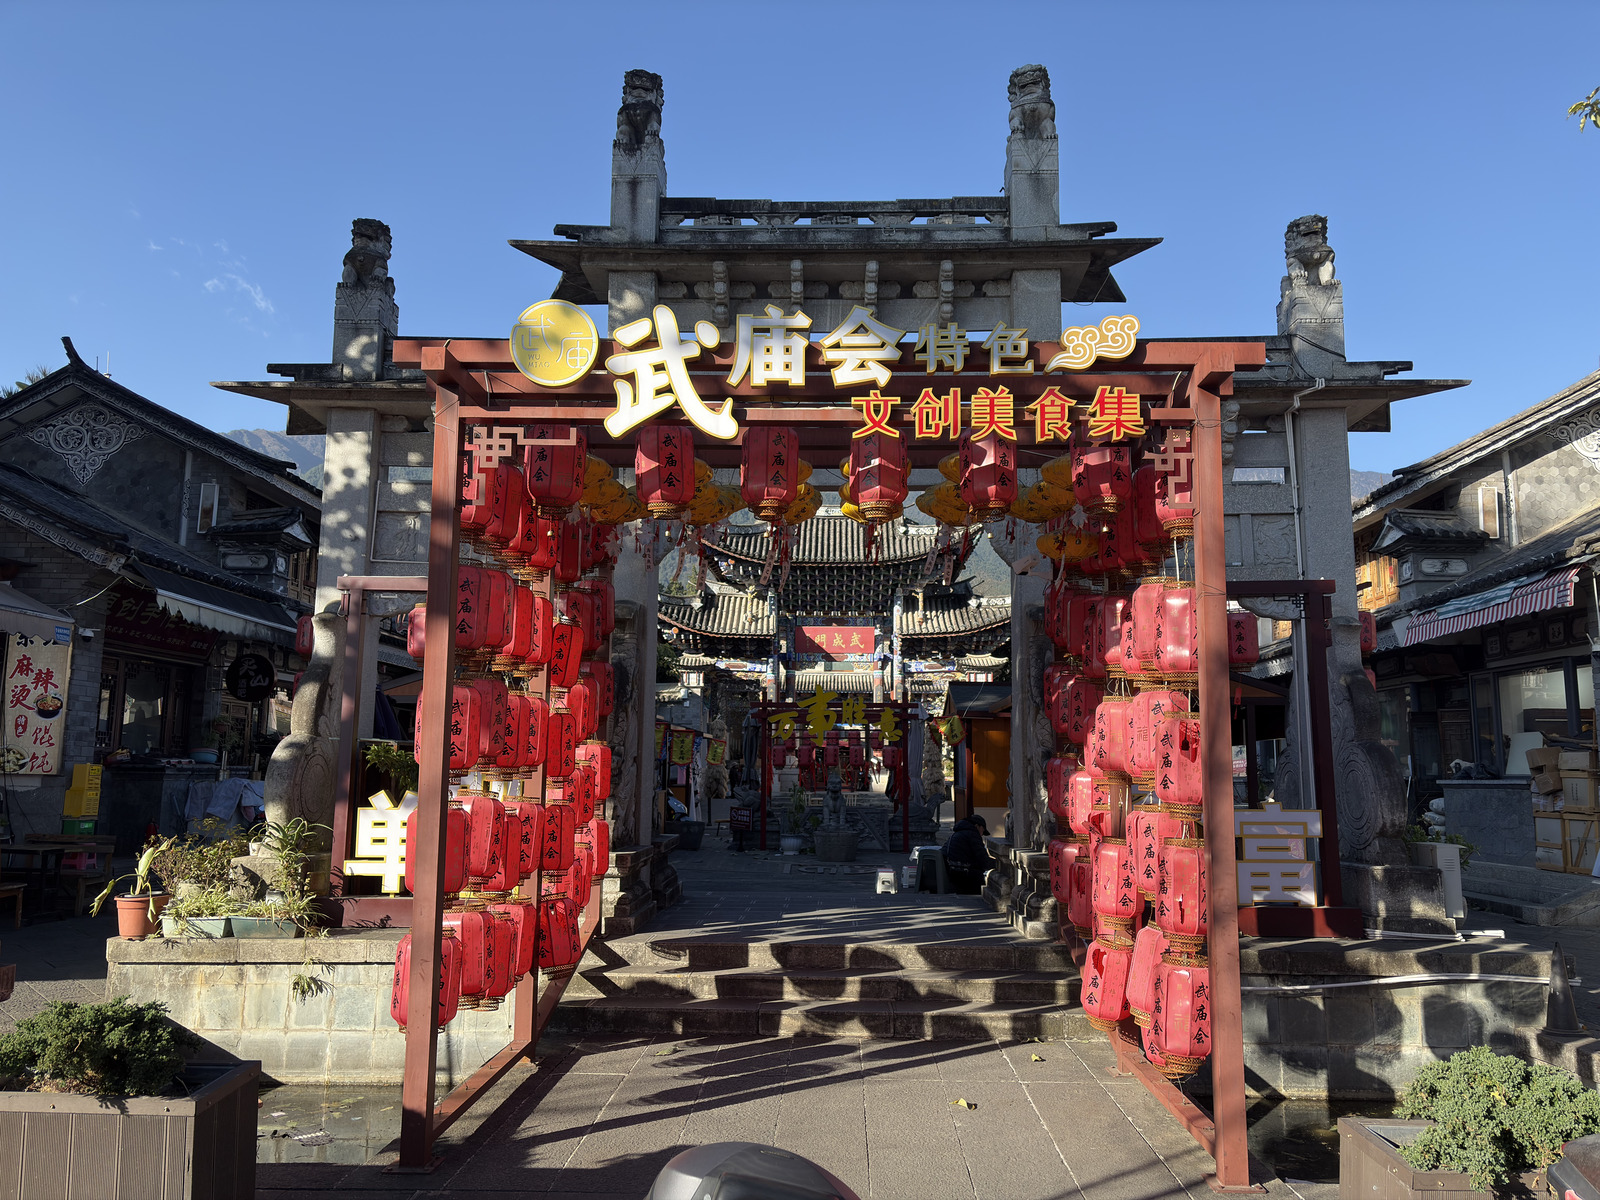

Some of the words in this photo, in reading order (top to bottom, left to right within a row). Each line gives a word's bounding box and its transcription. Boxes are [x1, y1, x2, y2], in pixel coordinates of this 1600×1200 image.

[528, 353, 541, 361] WU
[528, 361, 550, 369] MIAO
[851, 385, 1146, 444] 文创美食集
[662, 433, 681, 488] 武庙会
[770, 432, 788, 487] 武庙会
[1073, 441, 1087, 488] 庙会
[1112, 446, 1128, 483] 庙会
[456, 577, 474, 634] 武庙会
[550, 632, 567, 676] 武庙会
[1155, 604, 1163, 660] 武庙会
[1234, 620, 1247, 655] 武庙会
[491, 691, 504, 744] 武庙会
[1072, 690, 1083, 732] 武庙会
[1097, 711, 1107, 759] 武庙会
[563, 723, 573, 767] 武庙会
[1160, 730, 1174, 790] 武庙会
[567, 777, 577, 804] 武庙
[583, 773, 592, 814] 武庙会
[490, 812, 503, 865] 武庙会
[520, 814, 533, 863] 武庙会
[545, 811, 559, 859] 武庙会
[1143, 823, 1156, 880] 武庙会
[1157, 856, 1170, 917] 武庙会
[486, 923, 494, 980] 武庙会
[1085, 974, 1100, 1006] 庙会
[1152, 975, 1163, 1036] 武庙会
[1193, 982, 1209, 1045] 武庙会
